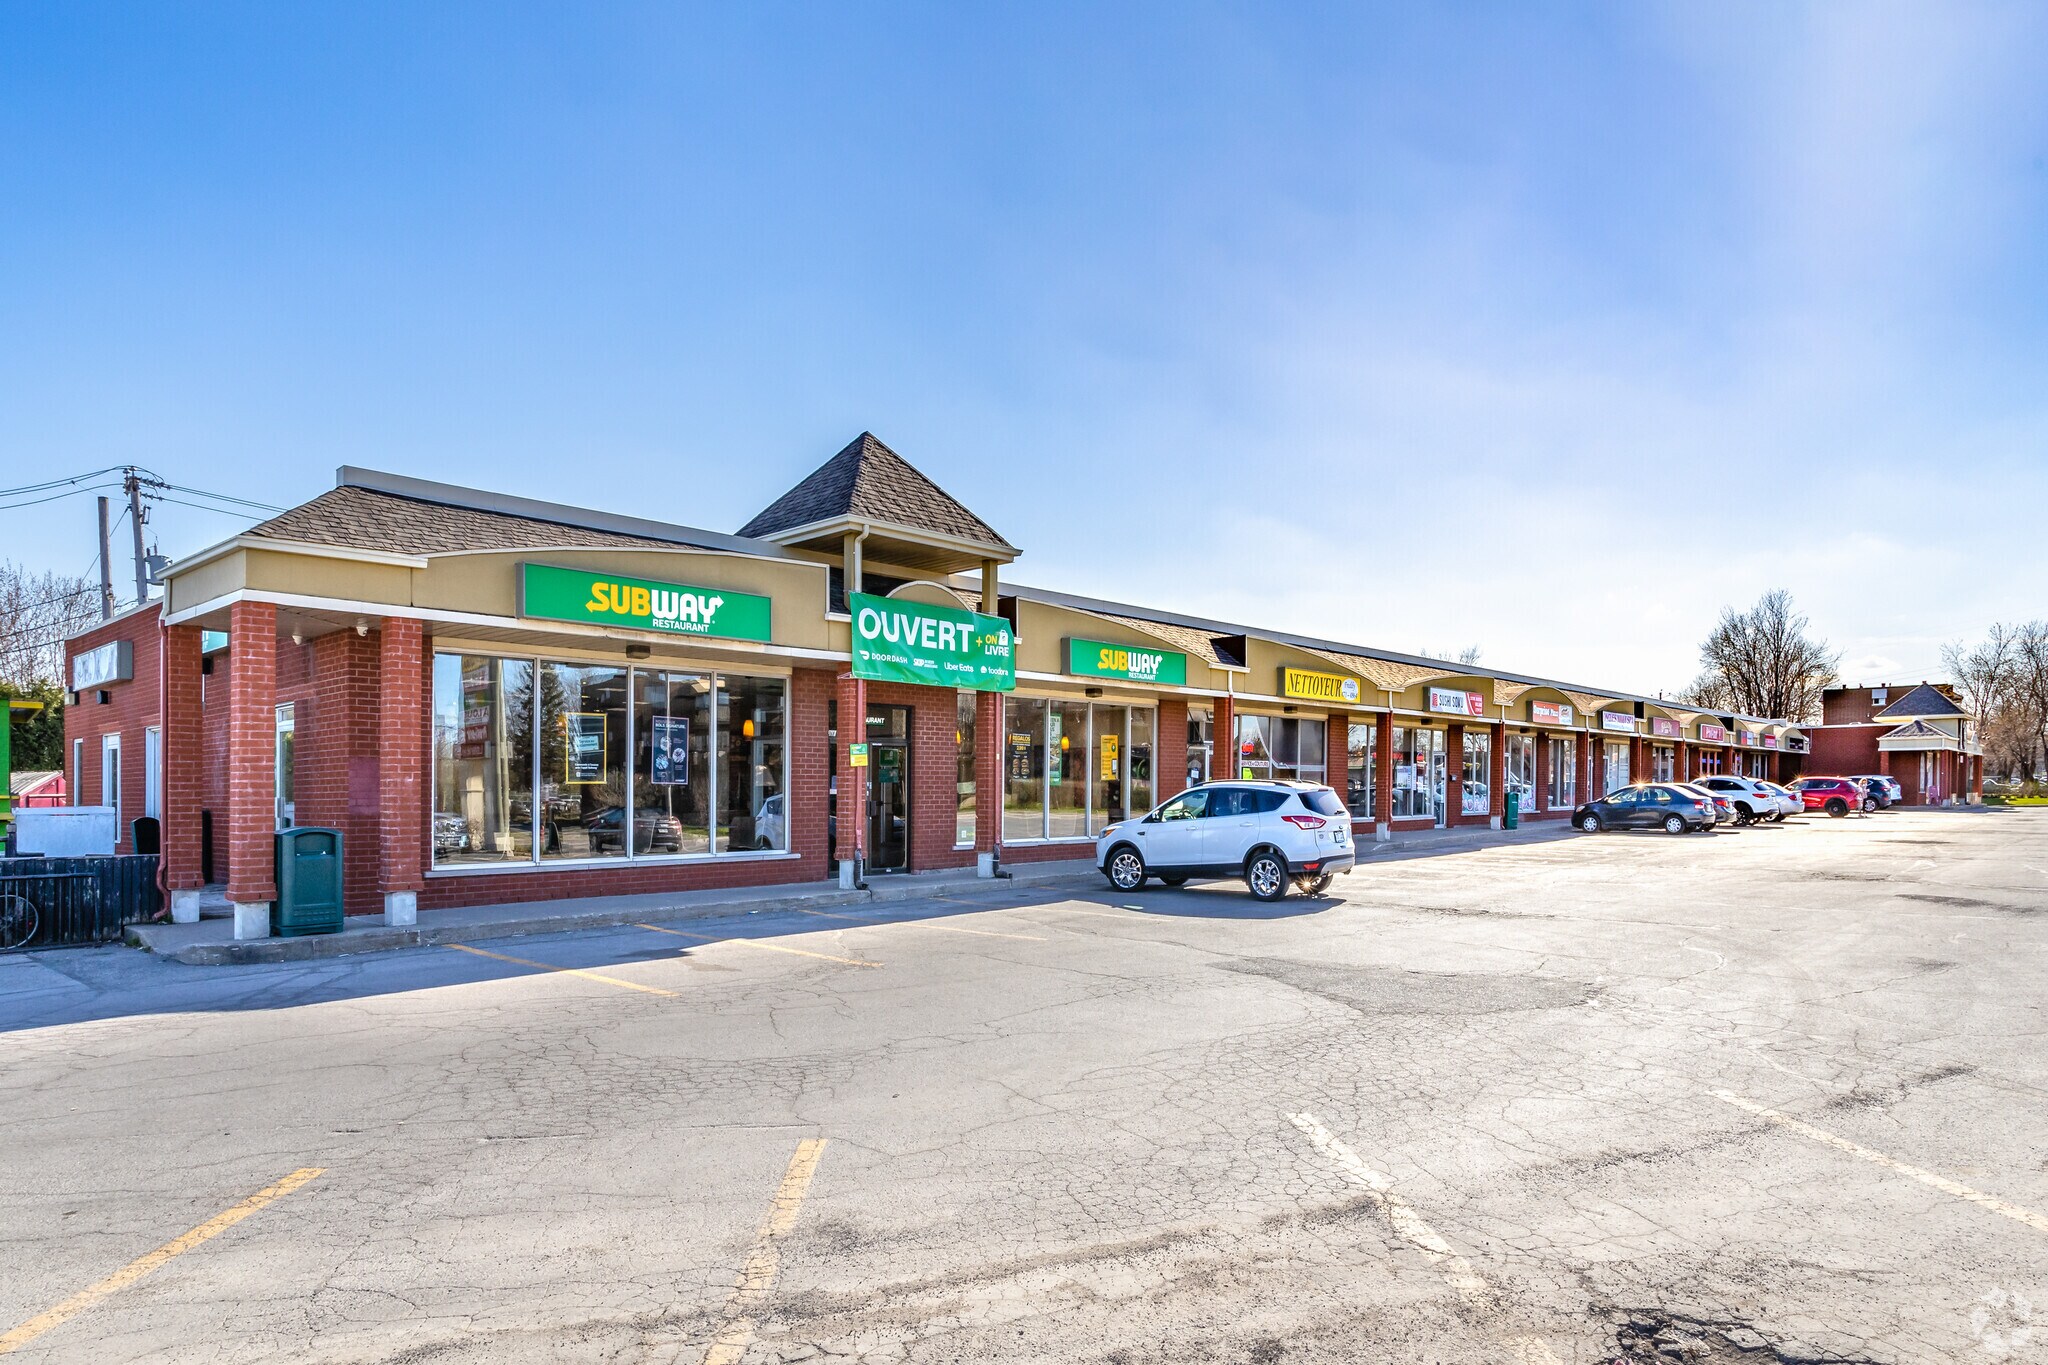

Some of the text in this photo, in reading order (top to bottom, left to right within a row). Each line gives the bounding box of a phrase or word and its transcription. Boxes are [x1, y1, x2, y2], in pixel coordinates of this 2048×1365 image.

[585, 582, 724, 624] SUBWAY
[652, 618, 710, 633] RESTAURANT
[858, 607, 975, 653] OUVERT
[985, 634, 997, 645] ON
[984, 644, 1010, 657] LIVRE
[871, 652, 908, 664] DOORDASH
[1097, 648, 1163, 675] SUBWAY
[943, 661, 959, 671] Uber
[959, 663, 974, 673] Eats
[988, 666, 1009, 676] foodora
[1128, 671, 1156, 681] RESTAURANT
[1287, 673, 1342, 698] NETTOYEUR
